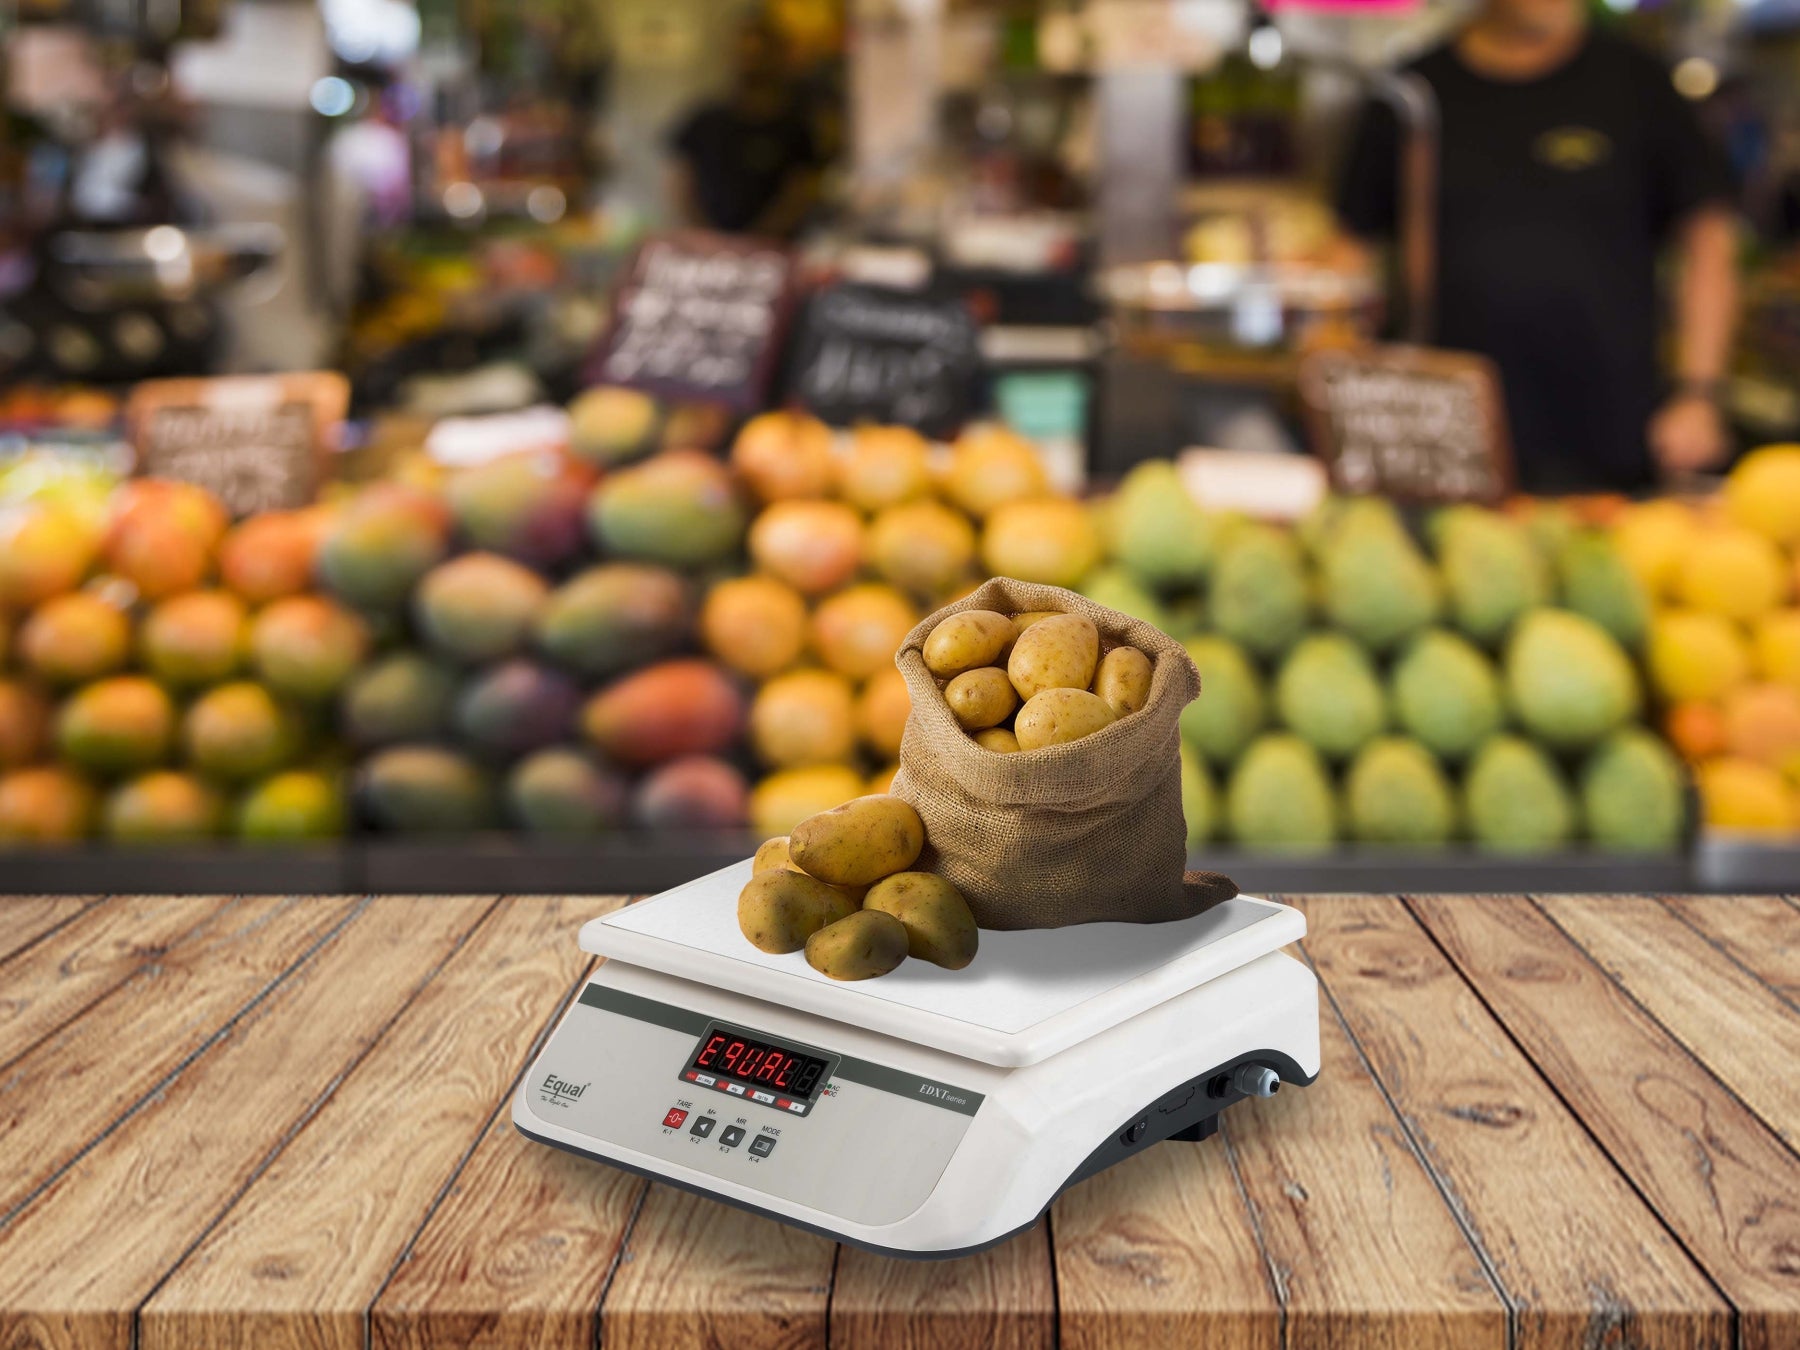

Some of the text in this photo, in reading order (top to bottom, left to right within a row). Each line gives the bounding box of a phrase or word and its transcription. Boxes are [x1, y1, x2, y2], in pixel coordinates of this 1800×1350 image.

[919, 1083, 967, 1105] EDXT series
[676, 1099, 693, 1109] TARE
[736, 1117, 747, 1126] MR
[762, 1125, 781, 1137] MODE
[719, 1146, 730, 1154] K-3
